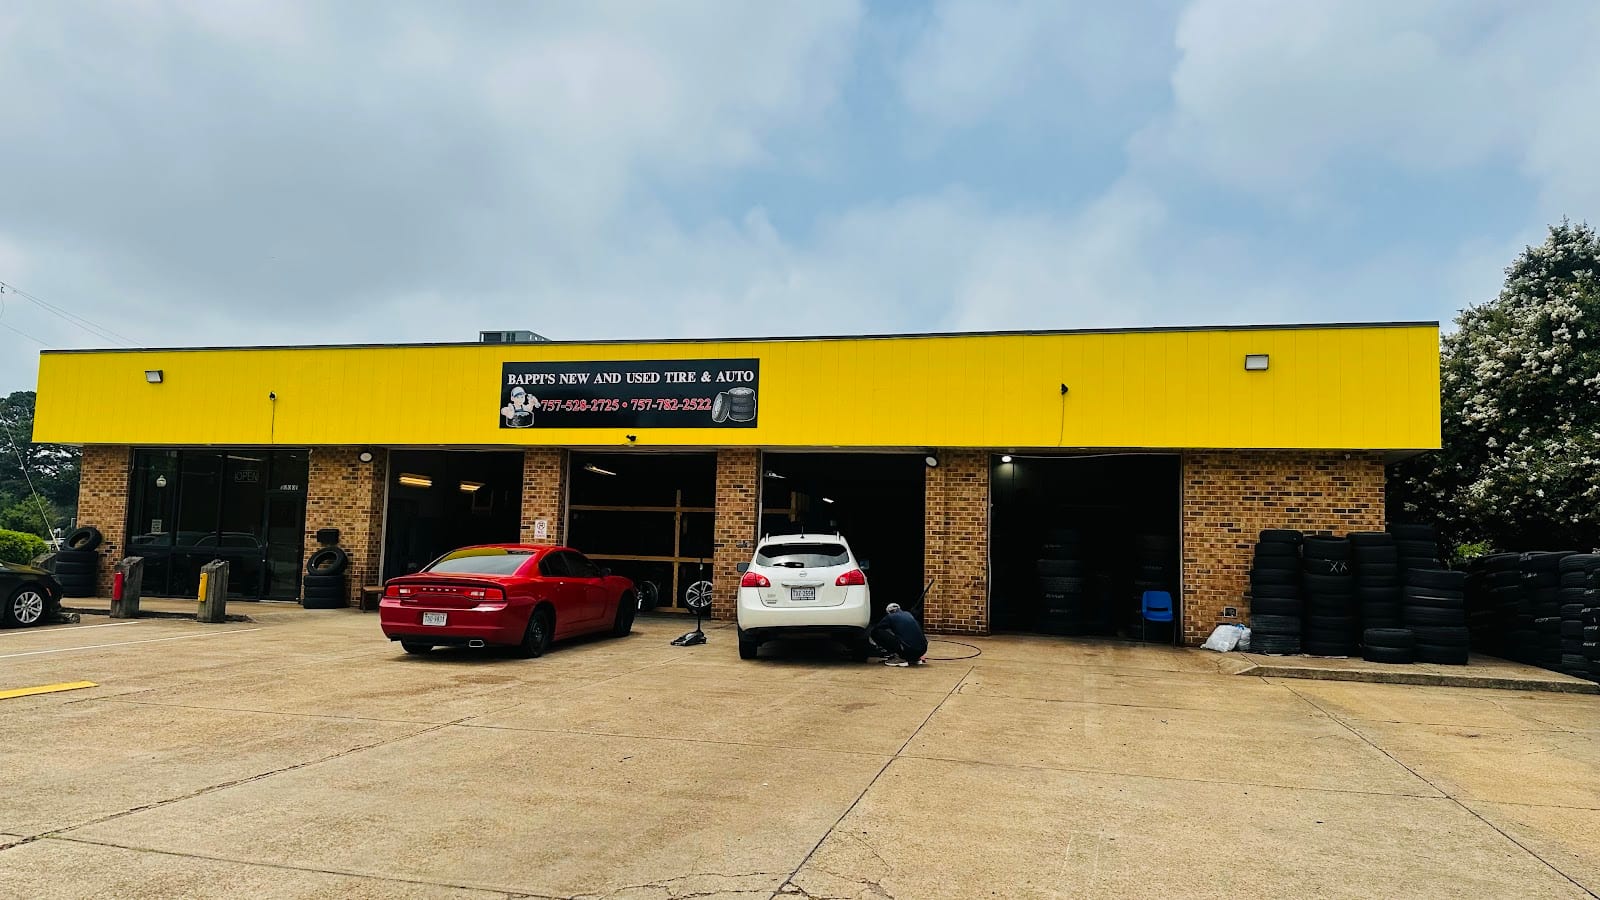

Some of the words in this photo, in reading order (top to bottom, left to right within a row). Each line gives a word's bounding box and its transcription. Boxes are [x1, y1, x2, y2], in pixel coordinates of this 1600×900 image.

[507, 373, 556, 385] BAPPI'S
[559, 373, 590, 384] NEW
[594, 372, 622, 384] AND
[626, 372, 660, 384] USED
[665, 371, 696, 383] TIRE
[701, 371, 712, 383] &
[715, 370, 755, 382] AUTO
[541, 399, 620, 411] 757-528-2725
[631, 398, 712, 411] 757-782-2522
[237, 471, 258, 481] OPEN
